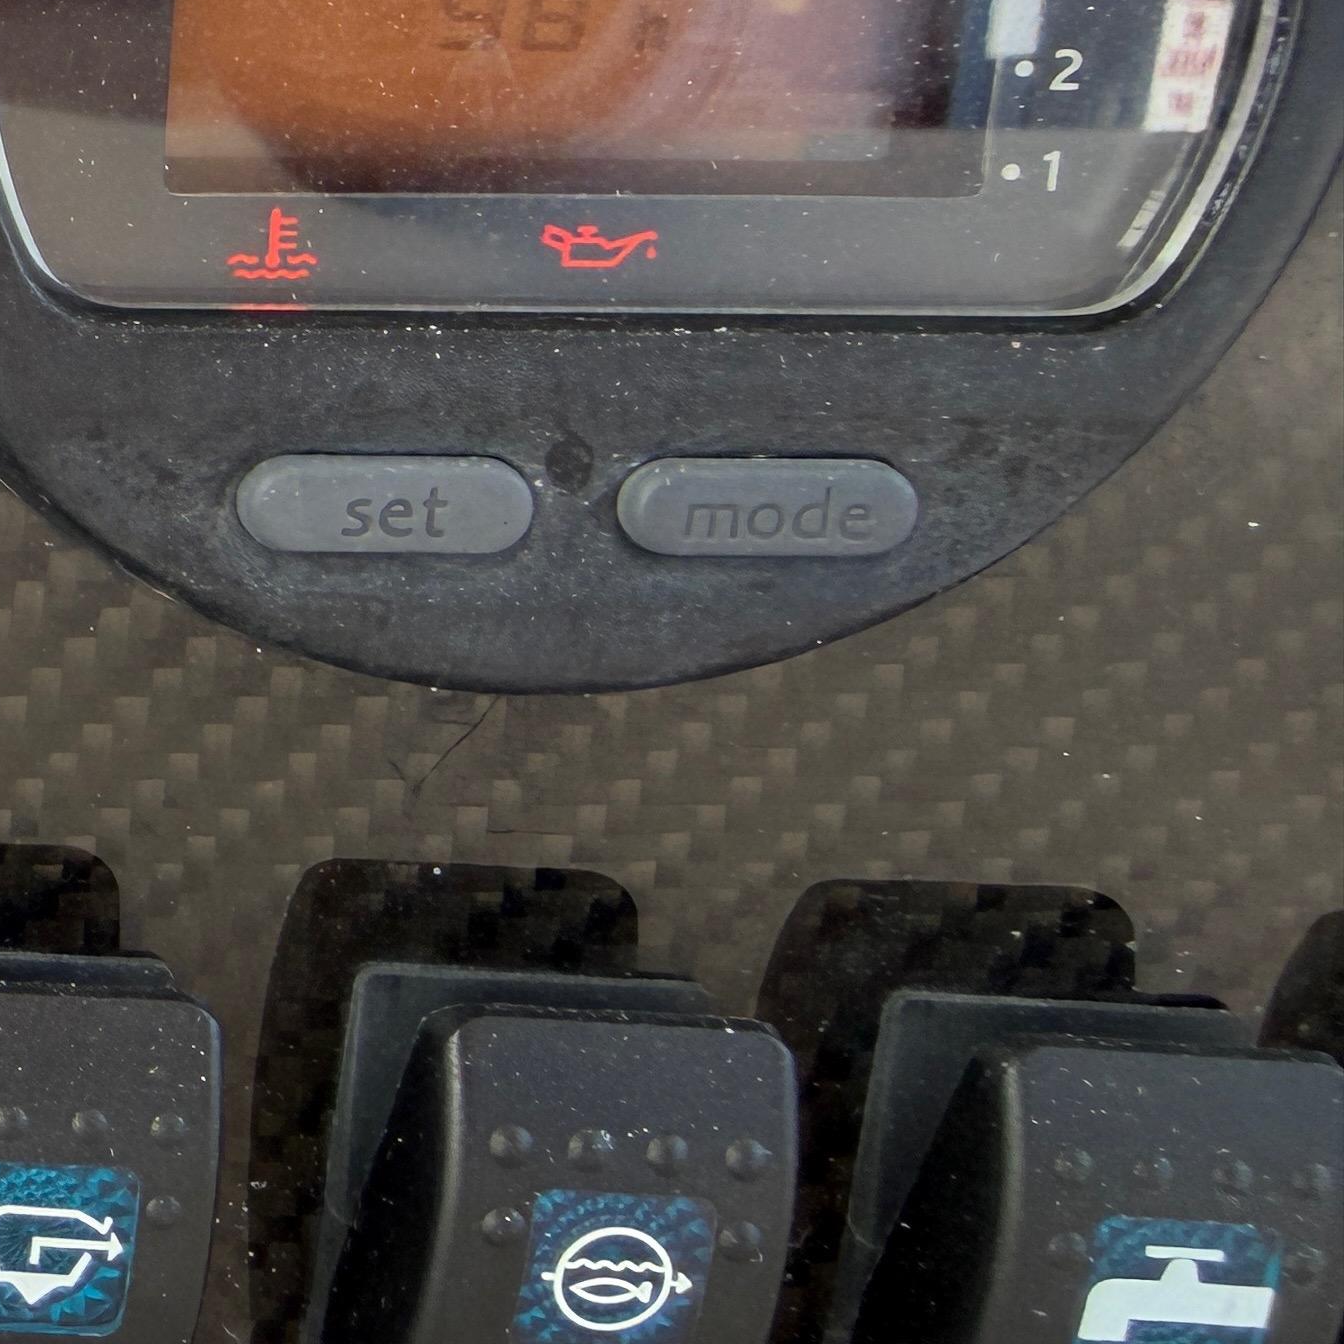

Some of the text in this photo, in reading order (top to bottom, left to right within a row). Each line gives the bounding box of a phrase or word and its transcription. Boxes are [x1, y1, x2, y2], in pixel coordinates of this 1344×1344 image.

[1048, 50, 1082, 92] 2
[1039, 152, 1060, 192] 1
[340, 486, 449, 539] set
[683, 487, 874, 541] mode
